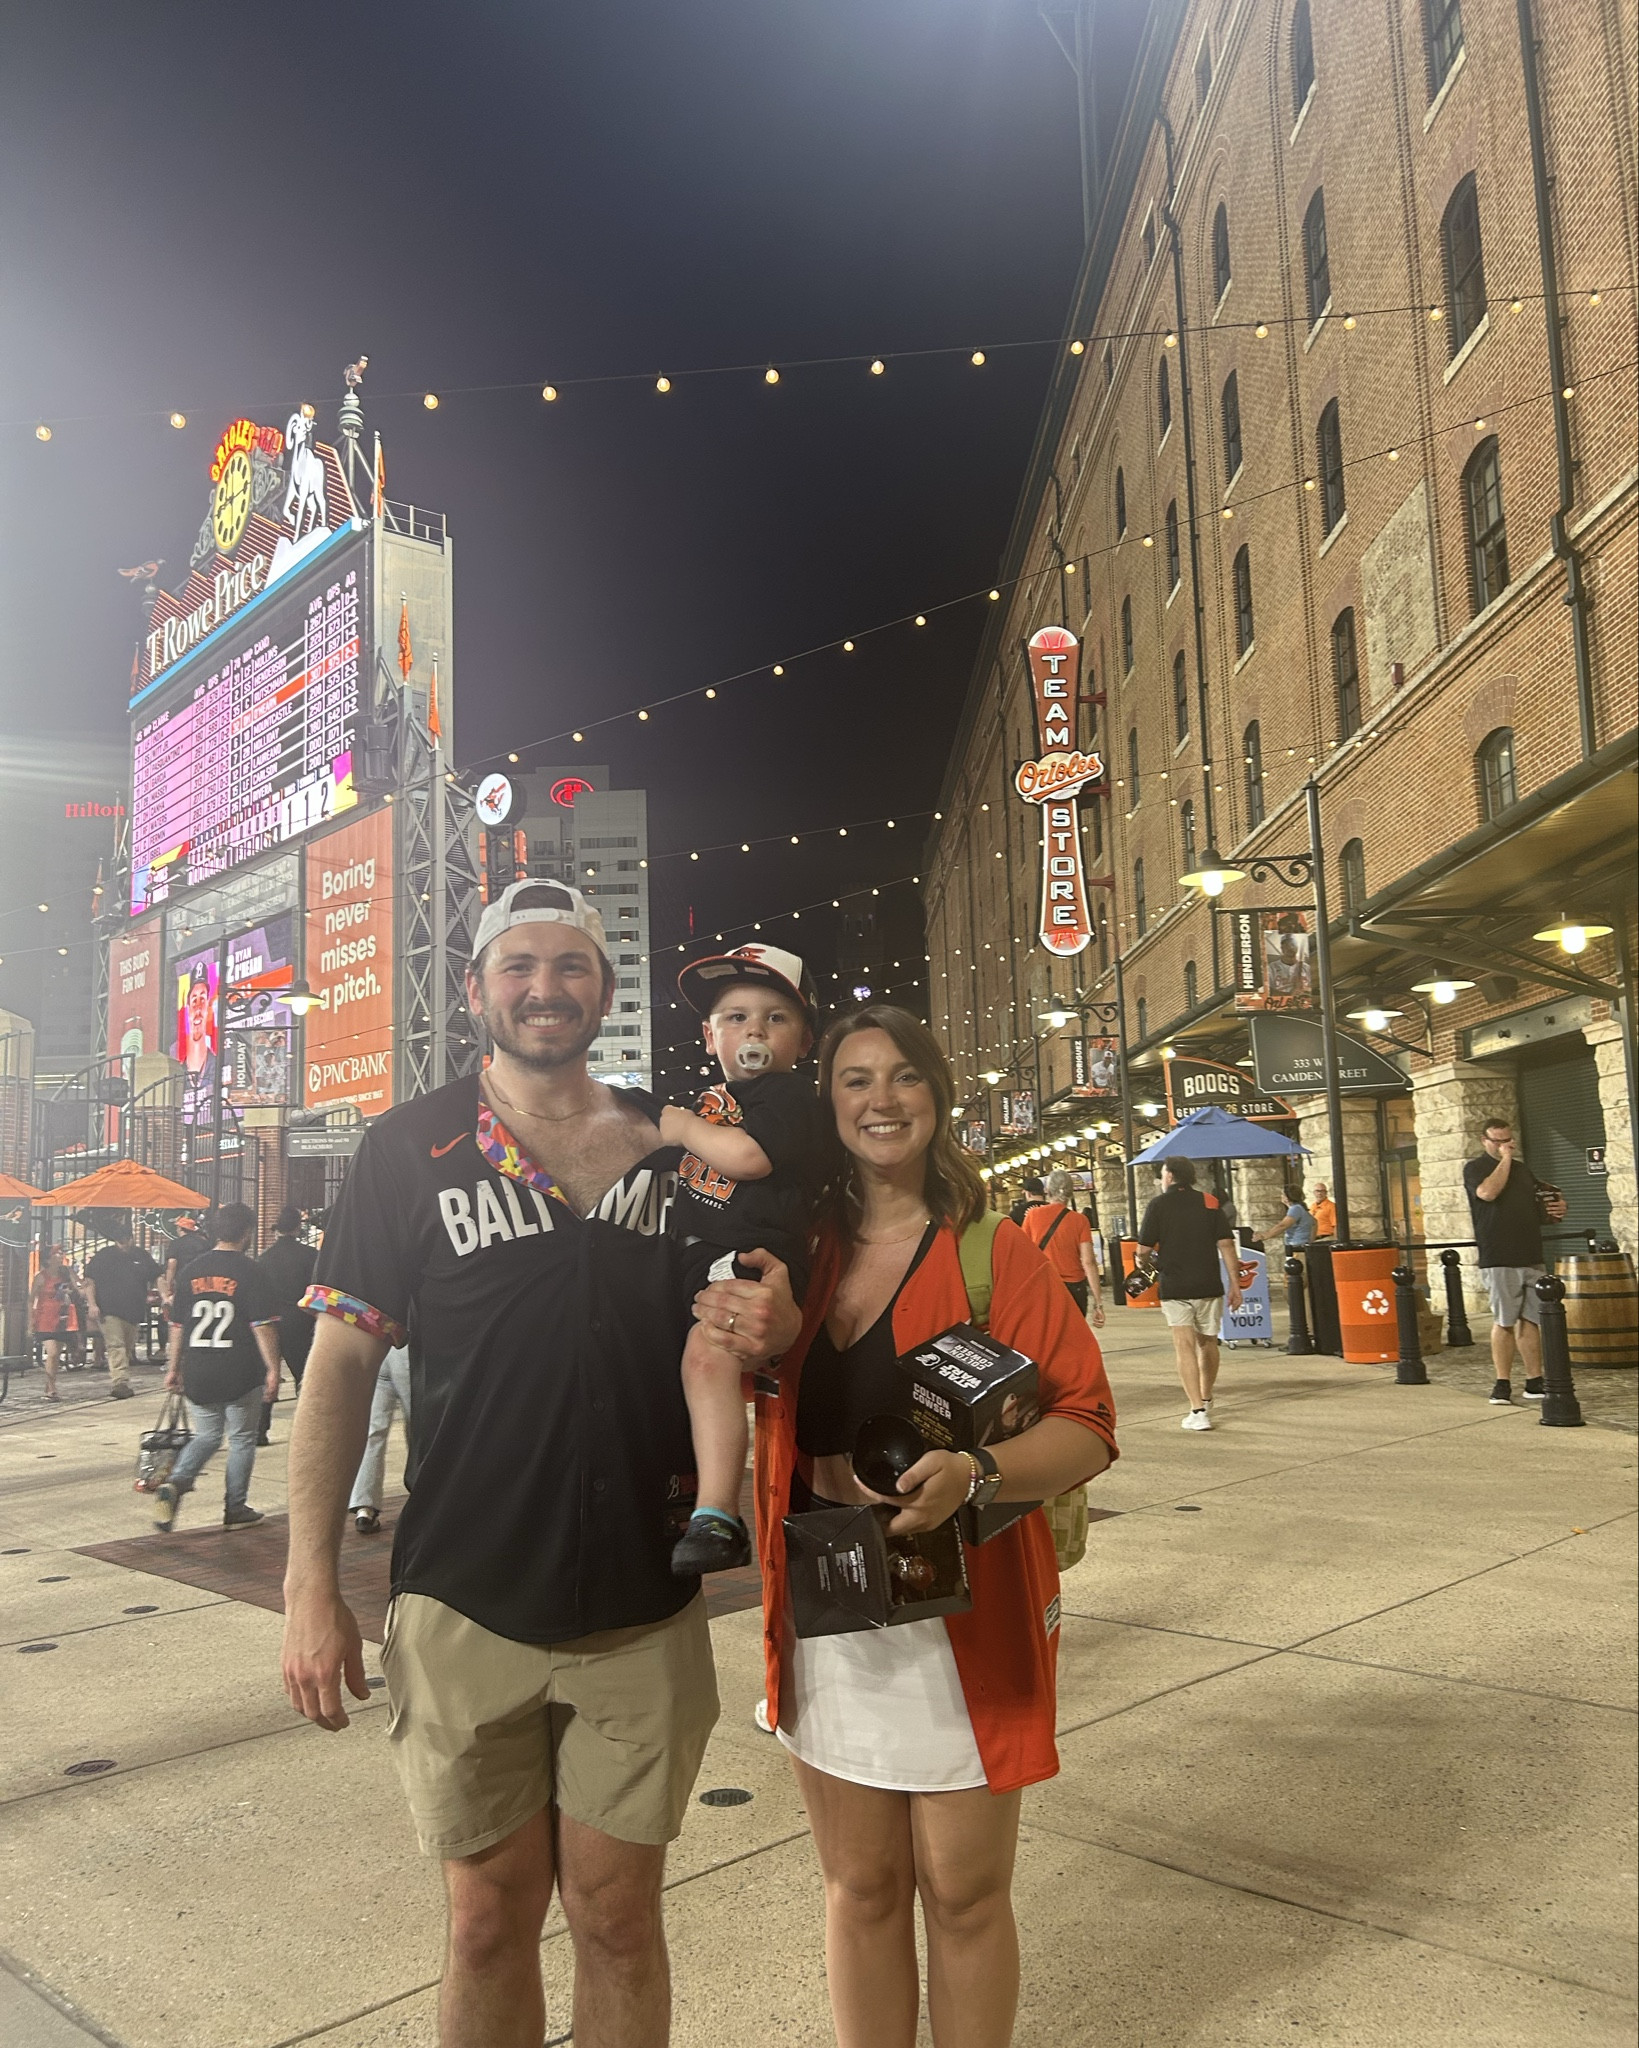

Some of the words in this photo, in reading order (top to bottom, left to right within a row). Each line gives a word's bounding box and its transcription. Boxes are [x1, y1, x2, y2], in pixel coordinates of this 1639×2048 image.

[326, 581, 340, 601] OPS
[254, 643, 277, 670] MULLINS
[309, 611, 321, 631] .267
[345, 586, 356, 605] 0-4
[234, 688, 239, 701] 2
[254, 655, 286, 686] HENDERSON
[345, 605, 356, 623] 1-4
[254, 671, 287, 703] RUTSCHMAN
[345, 623, 356, 641] 1-4
[345, 641, 356, 659] 2-3
[253, 700, 293, 736] MOUNTCASTLE
[345, 659, 356, 677] 2-3
[345, 696, 356, 713] 0-2
[1042, 654, 1068, 746] TEAM
[233, 753, 237, 765] 7
[253, 726, 279, 752] HOLLIDAY
[345, 677, 356, 695] 1-3
[252, 761, 277, 785] CARLSON
[1018, 752, 1102, 794] Orioles
[65, 803, 124, 816] Hilton
[287, 800, 291, 835] 1
[304, 790, 308, 826] 1
[321, 779, 328, 818] 2
[322, 857, 375, 899] Boring
[1051, 808, 1078, 926] STORE
[325, 897, 371, 935] never
[119, 958, 132, 977] THIS
[133, 951, 150, 971] BUD'S
[321, 935, 376, 974] misses
[1239, 914, 1254, 988] HENDERSON
[122, 976, 132, 994] FOR
[134, 971, 146, 988] YOU
[319, 988, 330, 1010] a
[334, 966, 382, 1014] pitch.
[236, 1042, 246, 1088] HOLLIDAY
[322, 1060, 350, 1088] PNC
[350, 1052, 389, 1083] BANK
[1074, 1040, 1084, 1084] RODRIGUEZ
[1272, 1072, 1322, 1083] CAMDEN
[1338, 1068, 1368, 1079] REET
[1293, 1060, 1310, 1069] 333
[1314, 1057, 1344, 1067] WT
[1183, 1072, 1240, 1098] BOOG'S
[1242, 1102, 1274, 1114] STORE
[189, 1300, 235, 1348] 22
[1230, 1304, 1263, 1316] HELP
[1230, 1316, 1264, 1328] YOU?
[949, 1349, 986, 1371] COLTON
[954, 1344, 994, 1368] COWSER
[938, 1364, 978, 1389] STAR
[944, 1364, 982, 1387] WARS
[912, 1390, 952, 1420] COWSER
[914, 1382, 950, 1410] COLTON
